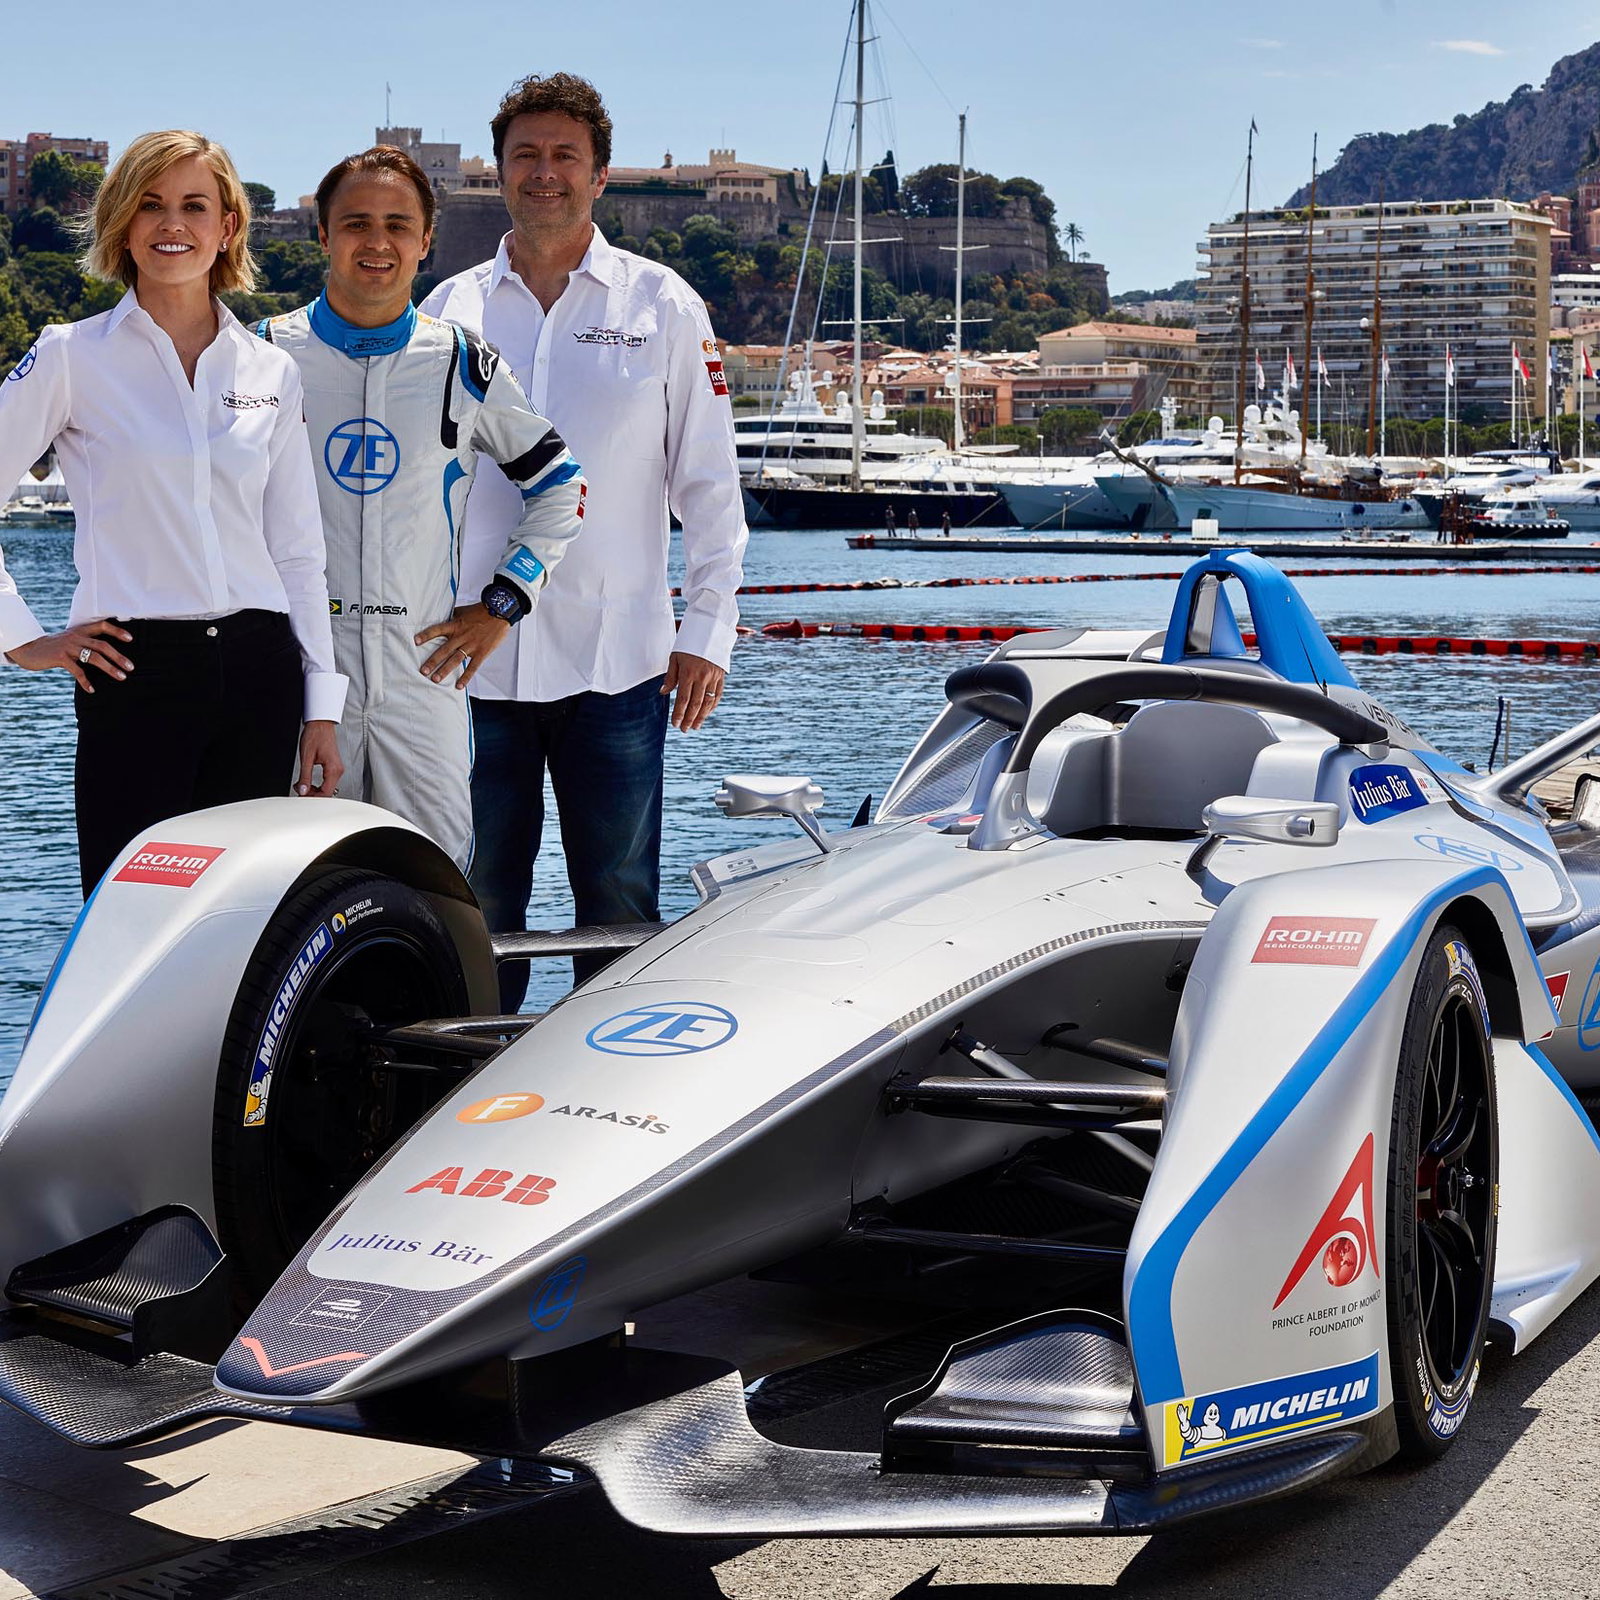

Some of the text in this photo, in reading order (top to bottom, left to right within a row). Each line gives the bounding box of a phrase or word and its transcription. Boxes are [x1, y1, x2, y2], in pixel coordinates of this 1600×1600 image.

[573, 332, 647, 344] VENTURI
[710, 371, 725, 381] RO
[330, 430, 397, 481] ZF
[349, 603, 408, 616] F. MASSA
[1350, 780, 1393, 817] Julius
[1386, 774, 1412, 800] Bär
[128, 864, 199, 875] SEMICONDUCTOR
[133, 853, 208, 870] ROHM
[345, 898, 372, 918] MICHELIN
[1263, 943, 1359, 951] SEMICONDUCTOR
[1266, 929, 1364, 945] ROHM
[259, 929, 327, 1067] MICHELIN
[593, 1008, 733, 1052] ZF
[405, 1166, 557, 1206] ABB
[326, 1233, 493, 1266] Julius Bär
[532, 1261, 586, 1321] ZF
[1272, 1314, 1305, 1330] PRINCE
[1306, 1306, 1338, 1322] ALBERT
[1347, 1301, 1358, 1313] OF
[1359, 1289, 1381, 1309] MONACO
[1309, 1315, 1364, 1337] FOUNDATION
[1230, 1376, 1370, 1430] MICHELIN
